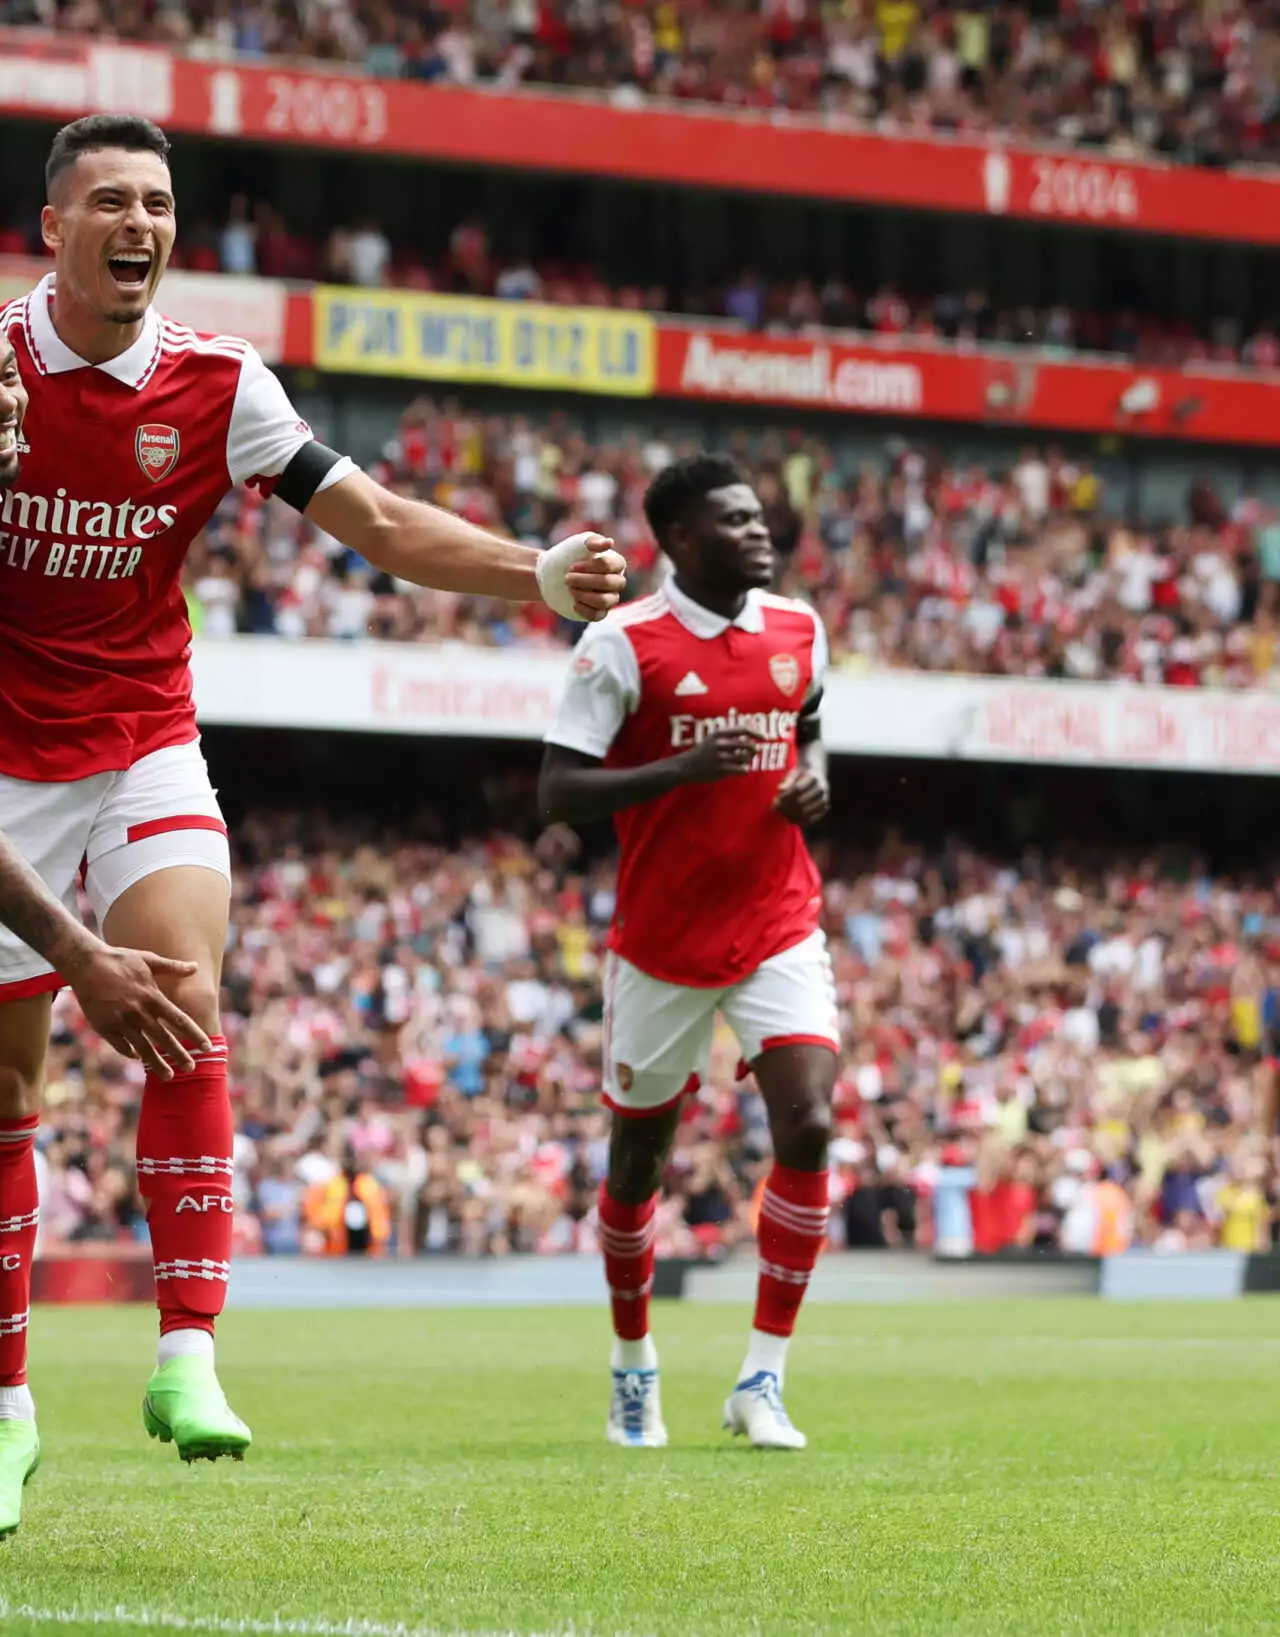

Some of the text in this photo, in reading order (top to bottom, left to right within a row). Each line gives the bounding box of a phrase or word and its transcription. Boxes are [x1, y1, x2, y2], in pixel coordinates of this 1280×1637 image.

[267, 75, 387, 143] 2003
[1028, 157, 1138, 221] 2004
[682, 334, 924, 414] Arsenal.com
[142, 432, 174, 445] Arsenal
[44, 542, 143, 580] BETTER
[175, 1194, 234, 1213] AFC
